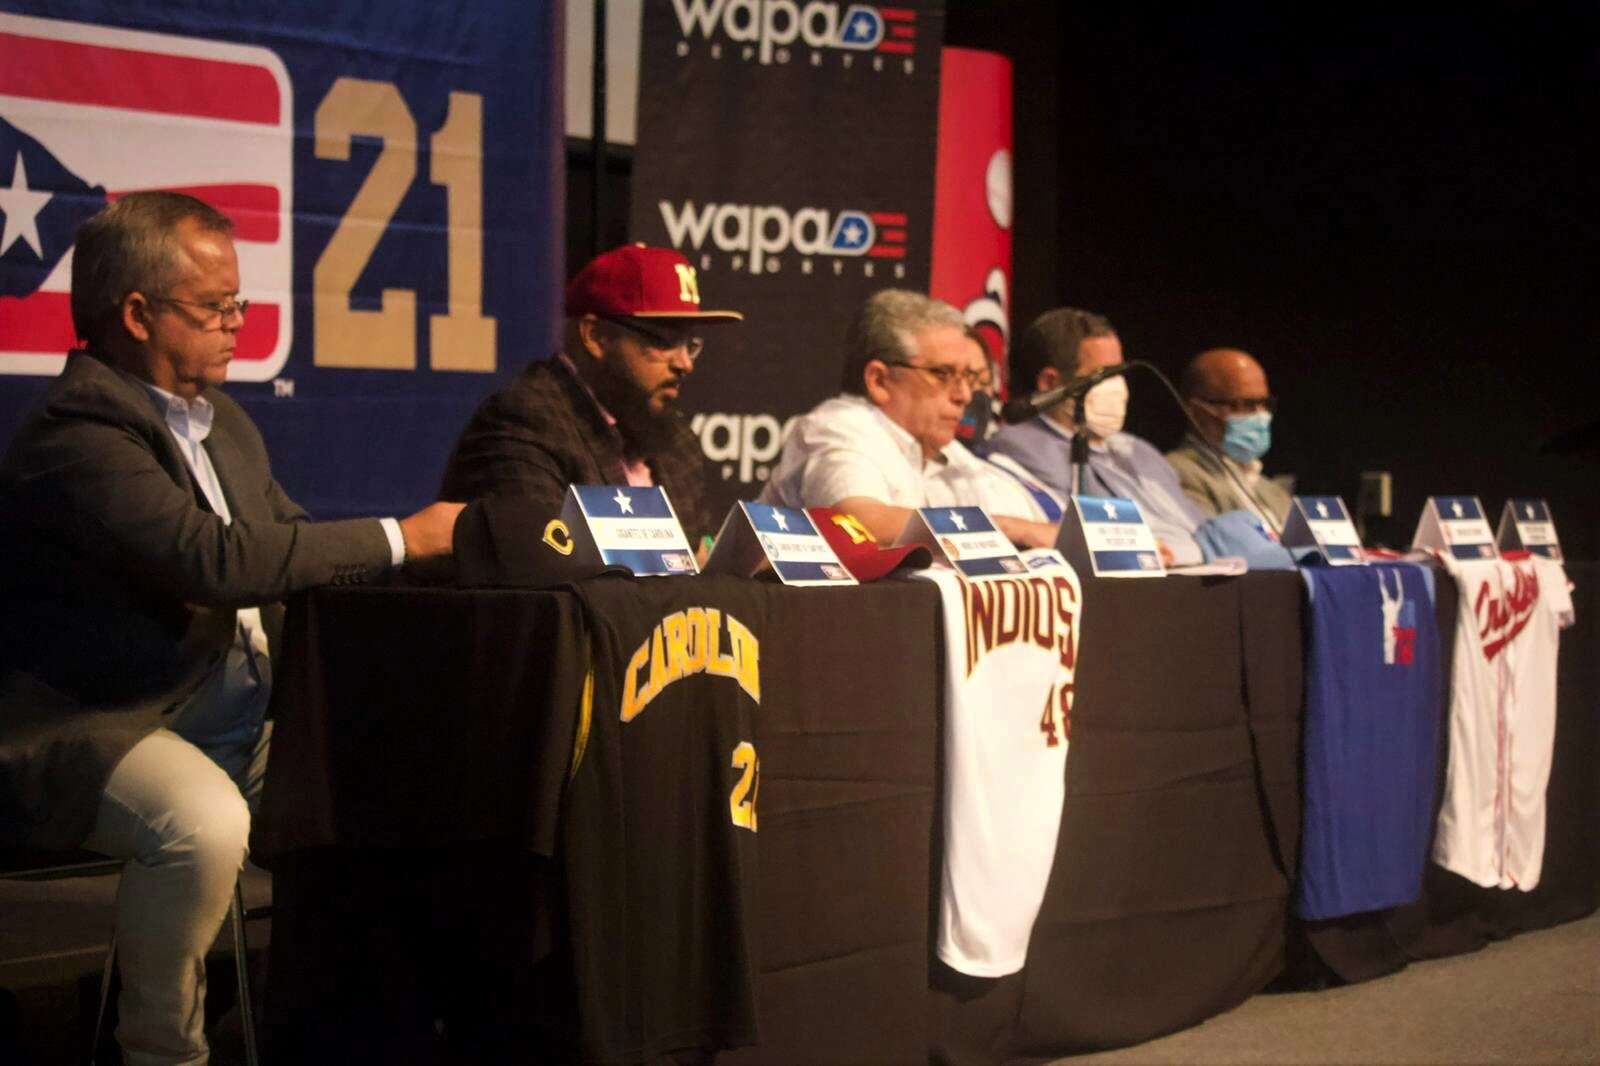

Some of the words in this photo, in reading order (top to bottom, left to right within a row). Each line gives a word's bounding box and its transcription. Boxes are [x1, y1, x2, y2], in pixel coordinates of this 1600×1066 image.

[313, 76, 497, 373] 21
[700, 253, 906, 279] EPORTES
[542, 518, 575, 556] C
[955, 574, 1076, 680] INDIOS
